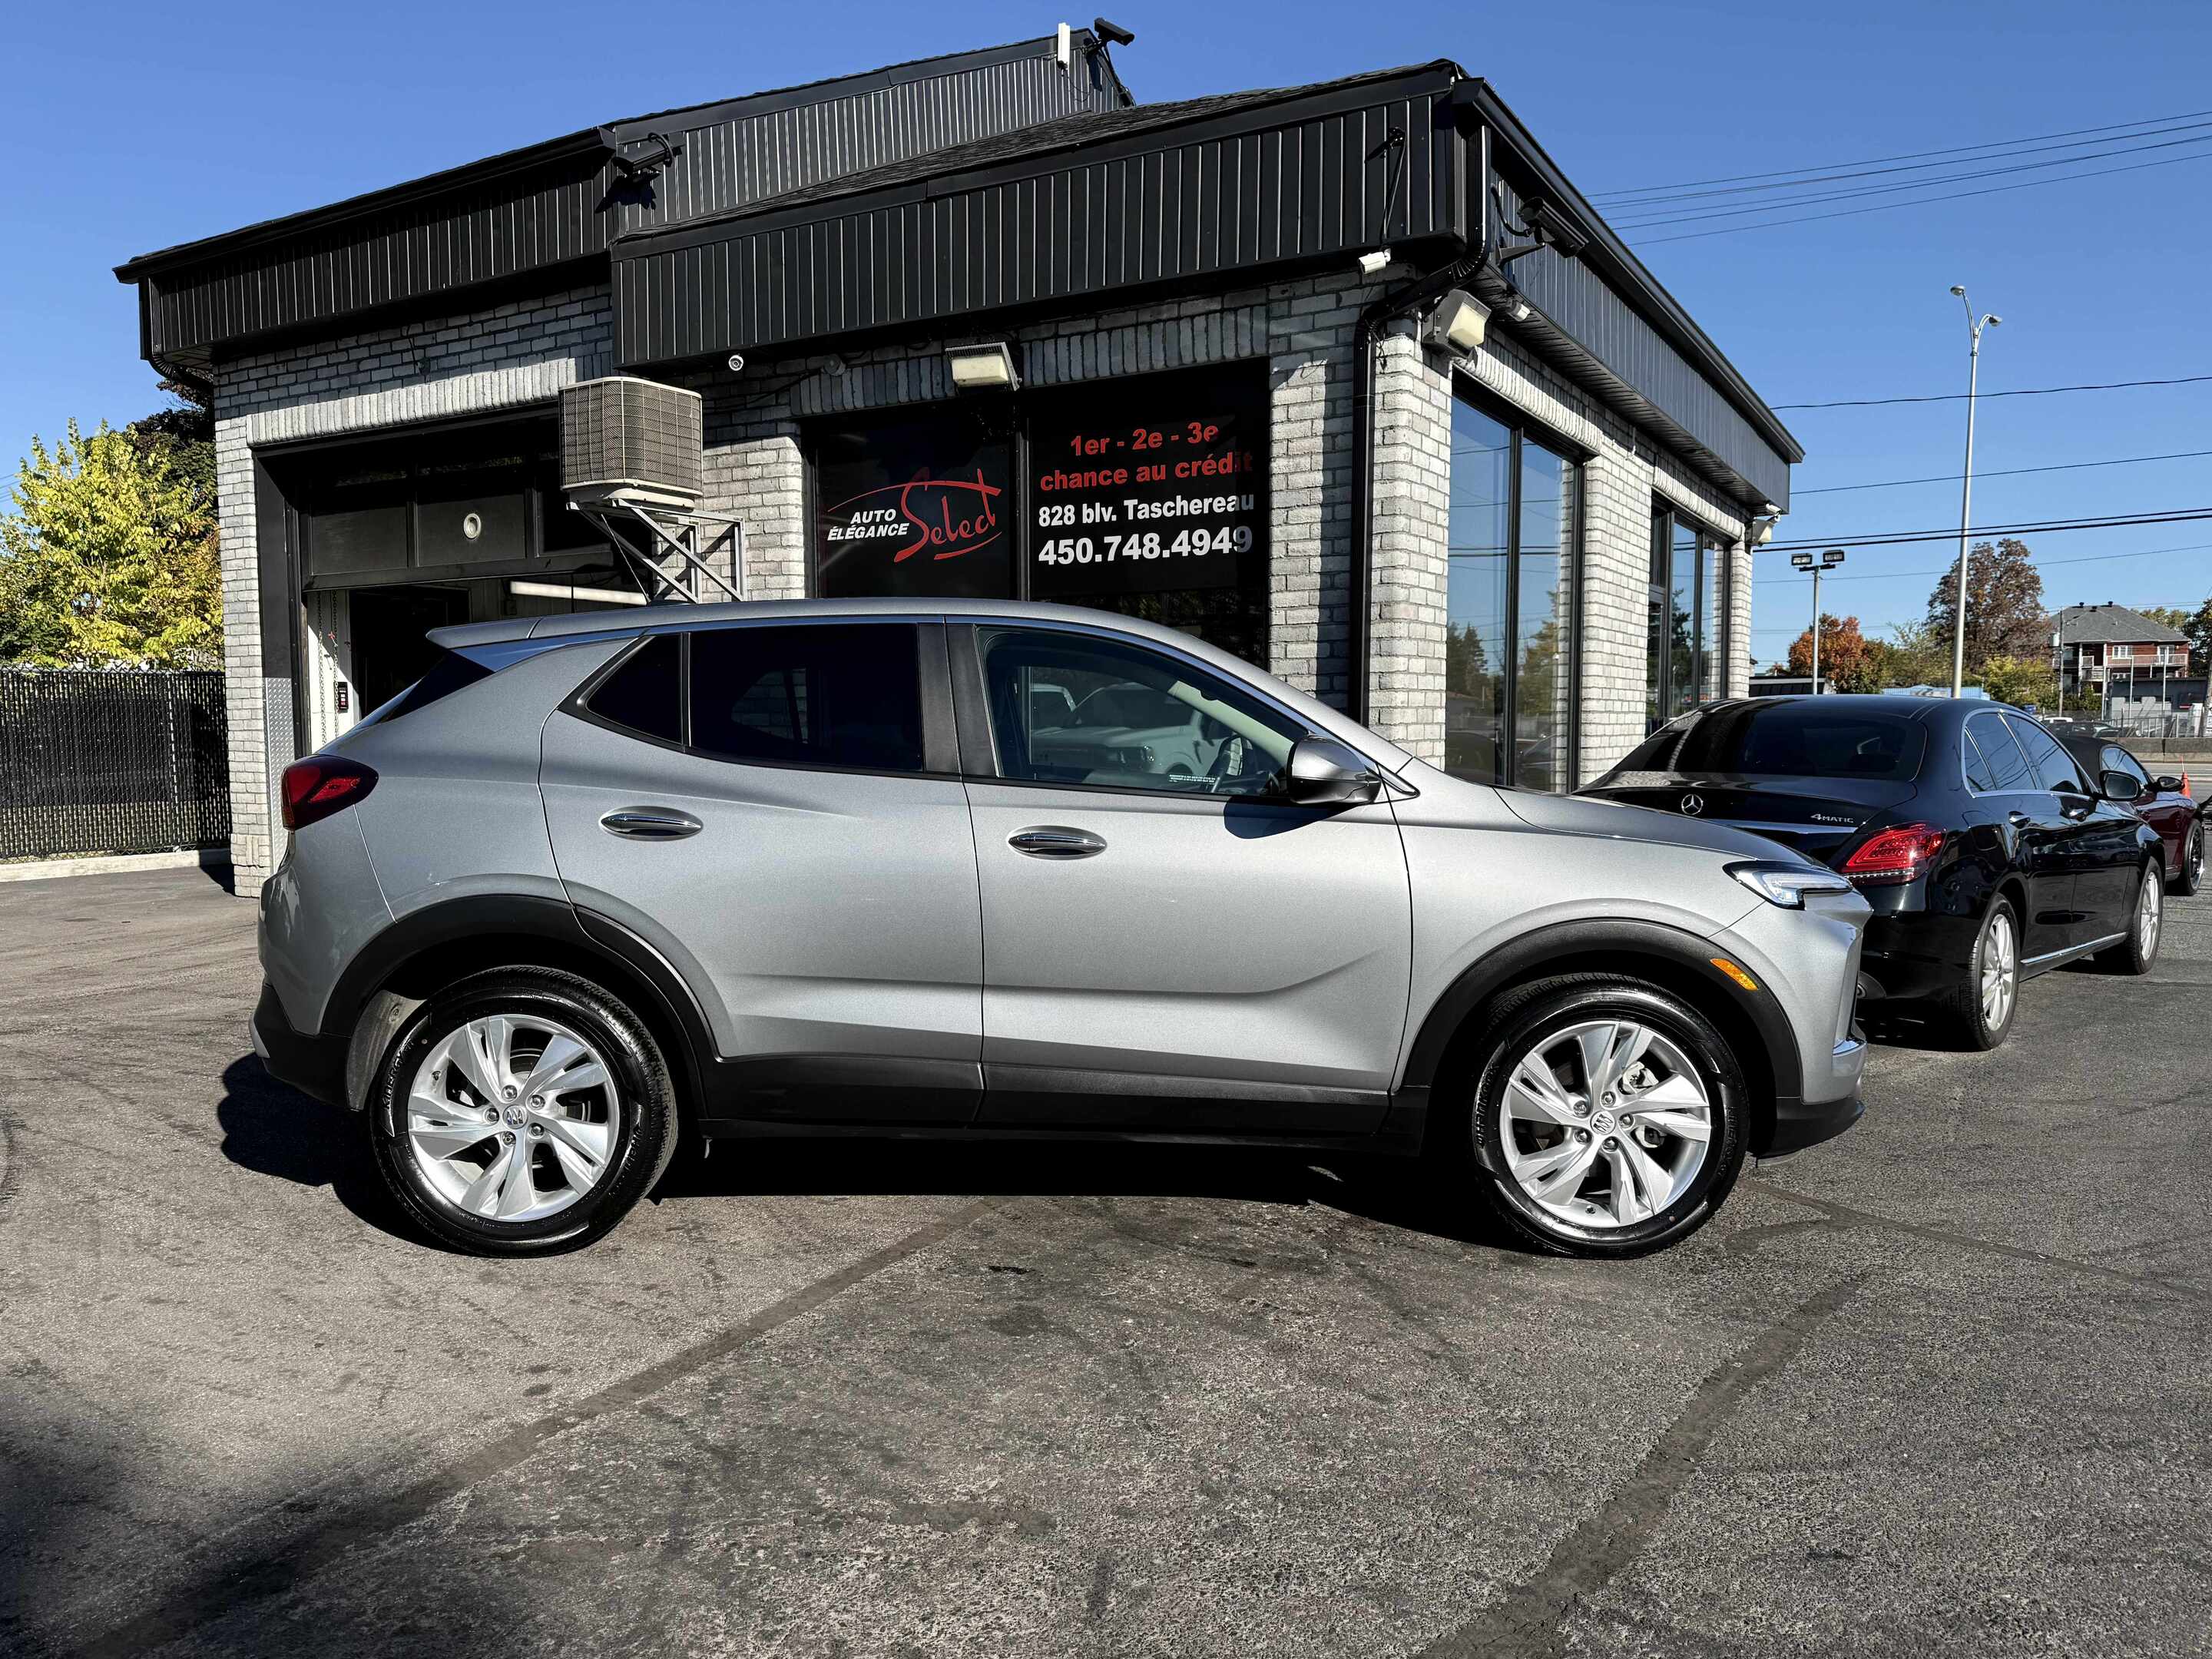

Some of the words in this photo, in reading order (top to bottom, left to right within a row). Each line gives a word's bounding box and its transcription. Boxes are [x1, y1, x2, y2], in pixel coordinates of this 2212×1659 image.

[1070, 435, 1111, 456] 1er
[1131, 429, 1164, 450] 2e
[1187, 422, 1220, 444] 3e
[1040, 469, 1128, 491] chance
[1136, 464, 1167, 482] au
[1174, 451, 1253, 478] crédit
[849, 508, 897, 525] AUTO
[893, 466, 1002, 563] Select
[1038, 505, 1076, 528] 828
[1082, 502, 1118, 524] blv.
[1123, 494, 1255, 521] Taschereau
[827, 522, 910, 541] ÉLÉGANCE
[1038, 525, 1253, 565] 450.748.4949
[1810, 813, 1855, 823] 4MATIC
